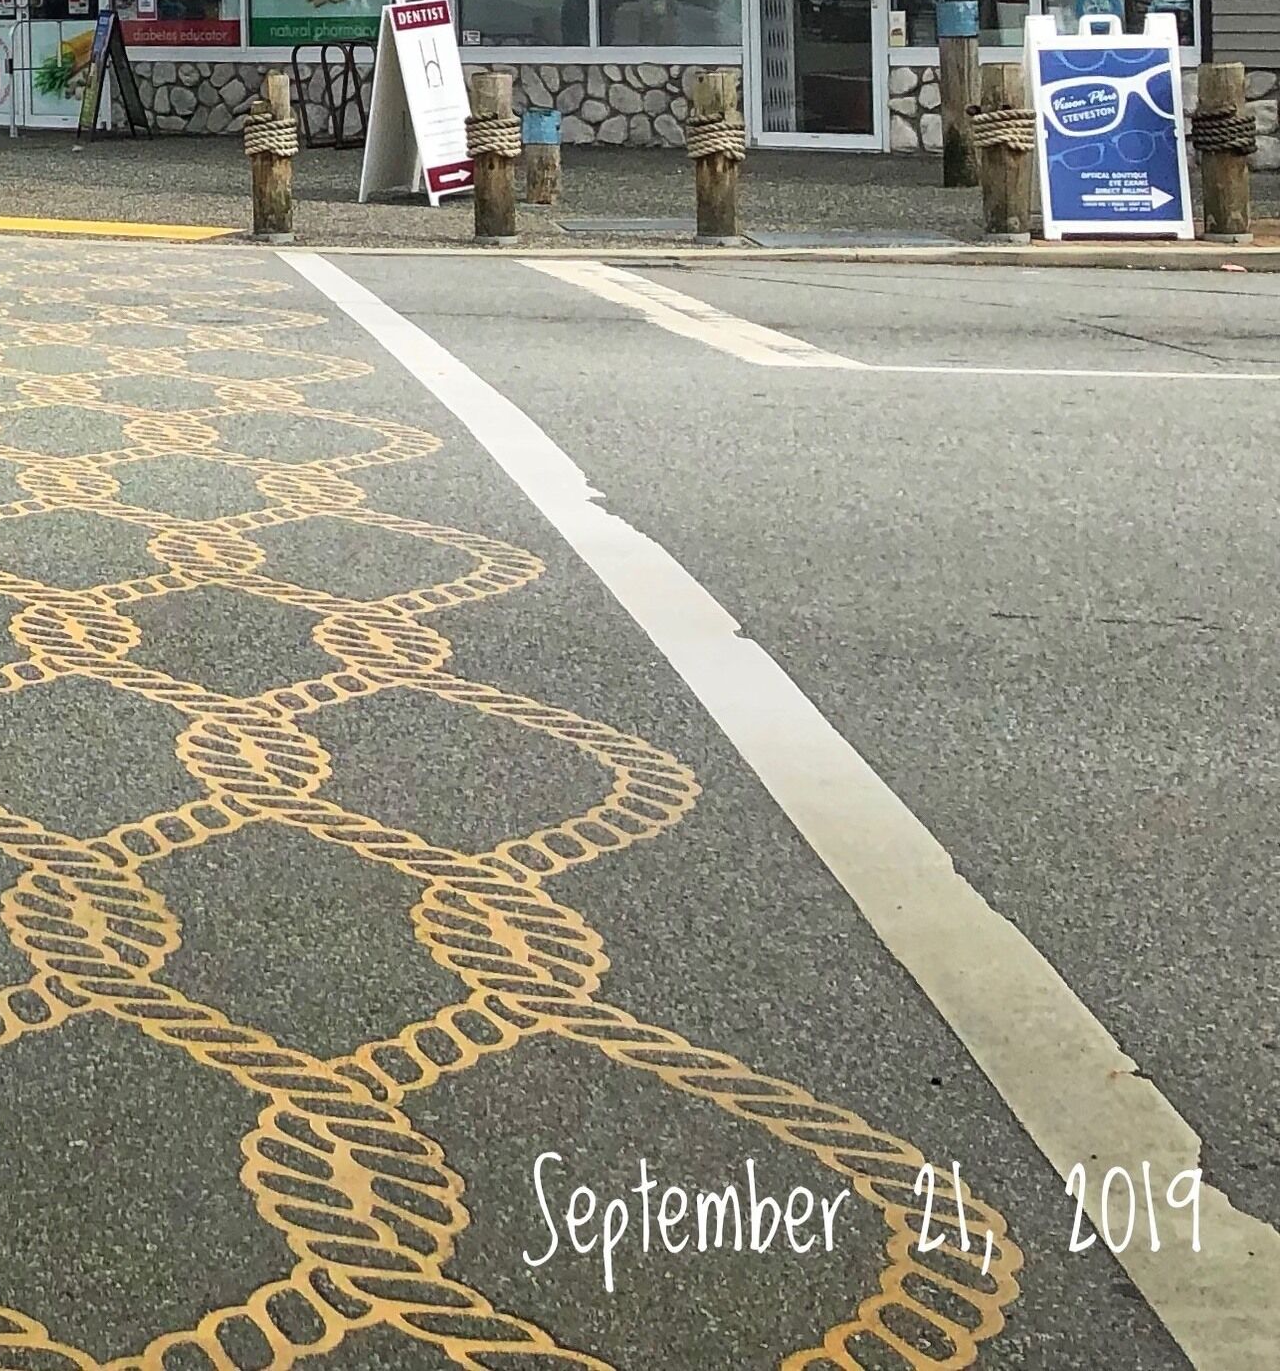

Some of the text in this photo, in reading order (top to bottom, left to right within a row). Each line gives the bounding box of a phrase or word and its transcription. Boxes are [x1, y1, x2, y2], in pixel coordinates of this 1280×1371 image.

[397, 6, 444, 25] DENTIST
[133, 28, 227, 41] diabetes educator
[270, 24, 310, 38] natural
[1053, 89, 1118, 110] Vision Plus
[1062, 107, 1116, 124] STEVESTON
